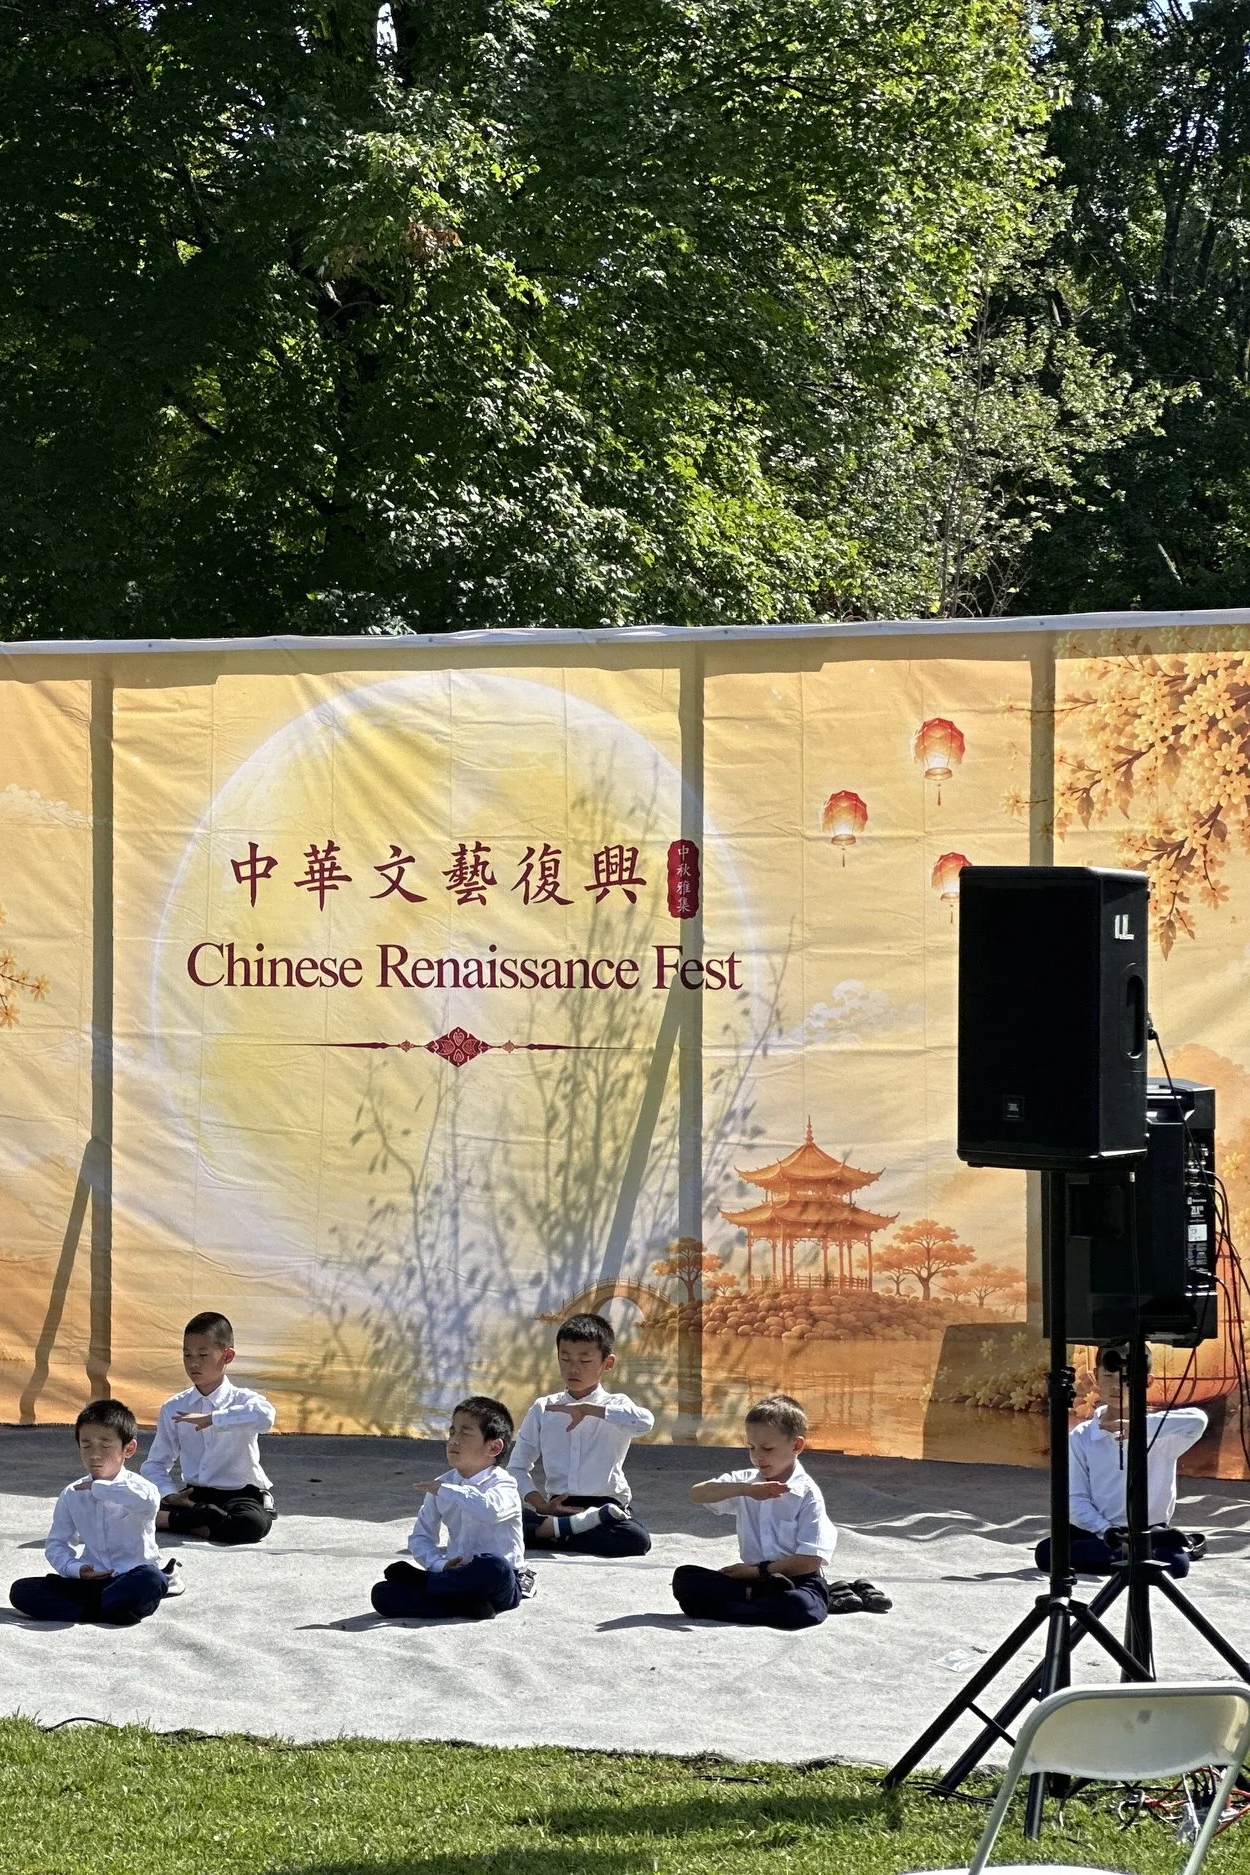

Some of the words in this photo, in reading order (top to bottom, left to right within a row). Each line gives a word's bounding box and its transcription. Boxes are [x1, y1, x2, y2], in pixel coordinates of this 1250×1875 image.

[231, 839, 647, 912] 中華文藝復興
[676, 844, 692, 913] 中秋雅集
[187, 942, 363, 988] Chinese
[375, 944, 640, 990] Renaissance
[652, 945, 744, 991] Fest
